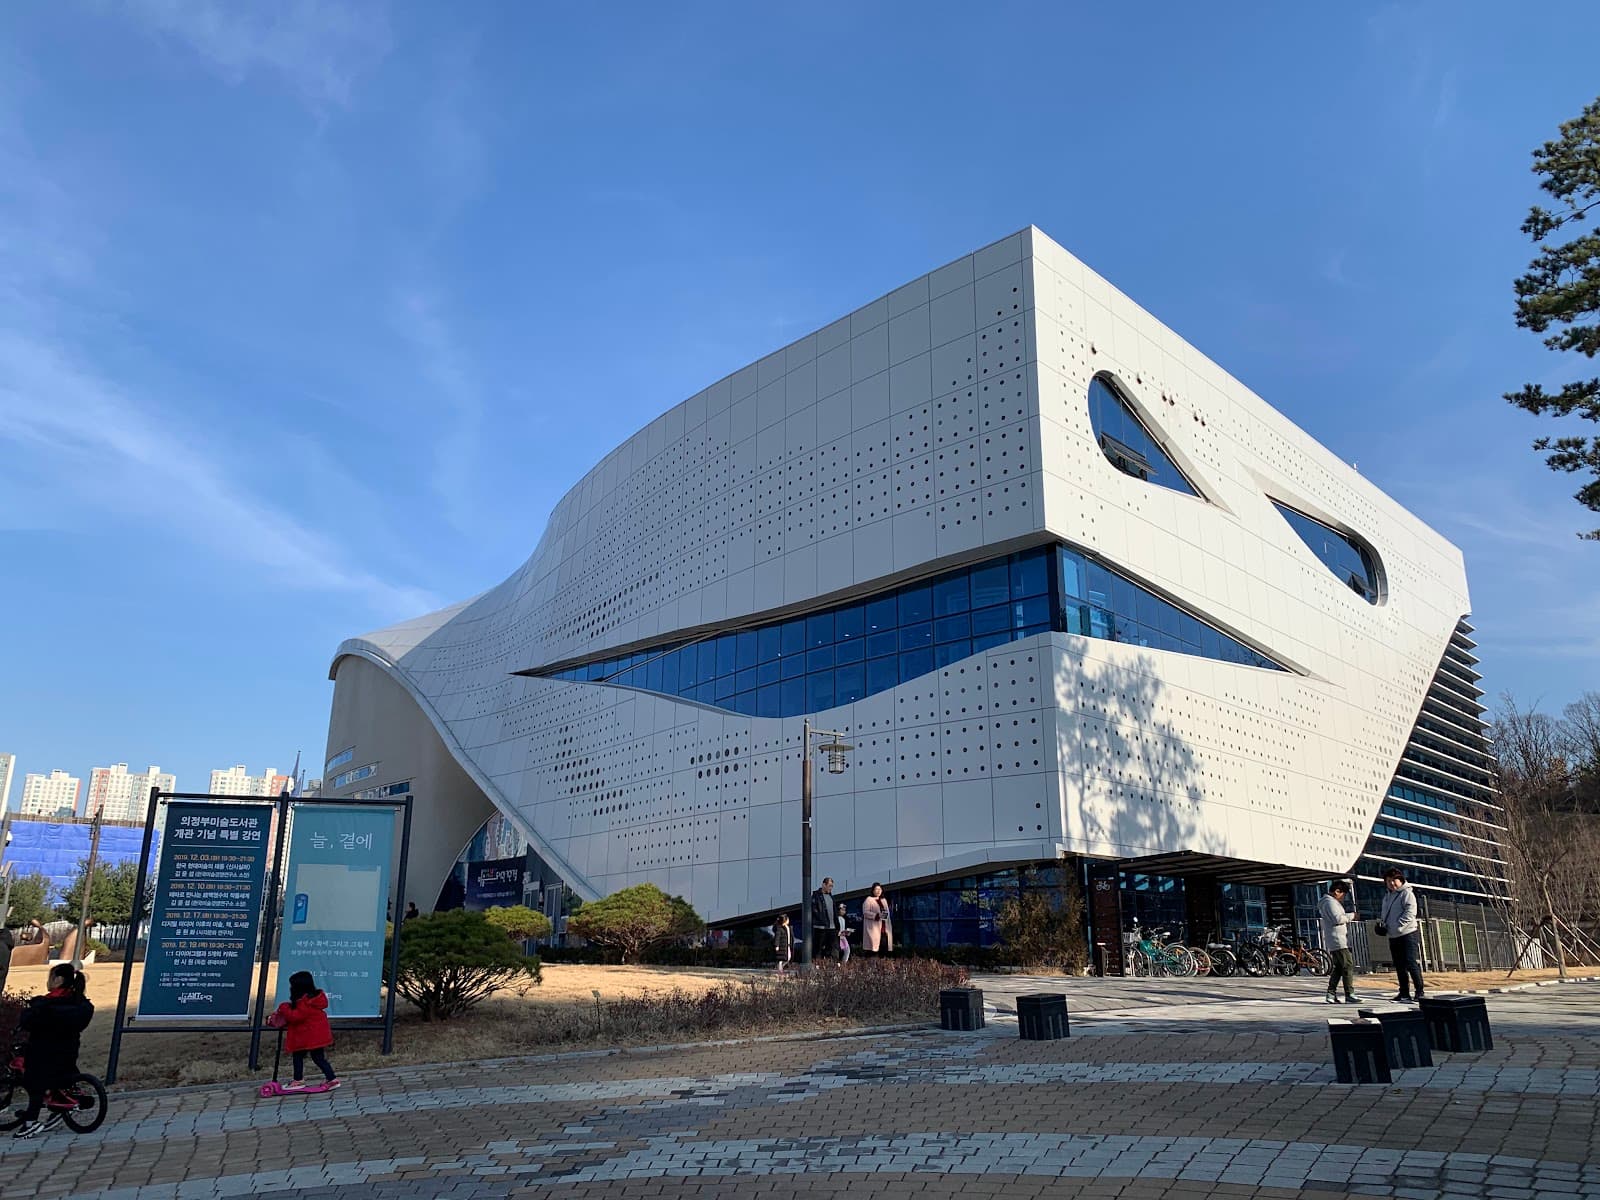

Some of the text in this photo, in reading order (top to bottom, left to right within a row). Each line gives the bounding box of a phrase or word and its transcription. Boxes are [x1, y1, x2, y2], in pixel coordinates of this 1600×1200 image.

[180, 816, 258, 828] 의정부미술도서관
[174, 828, 261, 841] 개관 기념 특별 강연
[309, 831, 373, 850] 늘, 곁에
[183, 911, 192, 919] 12.
